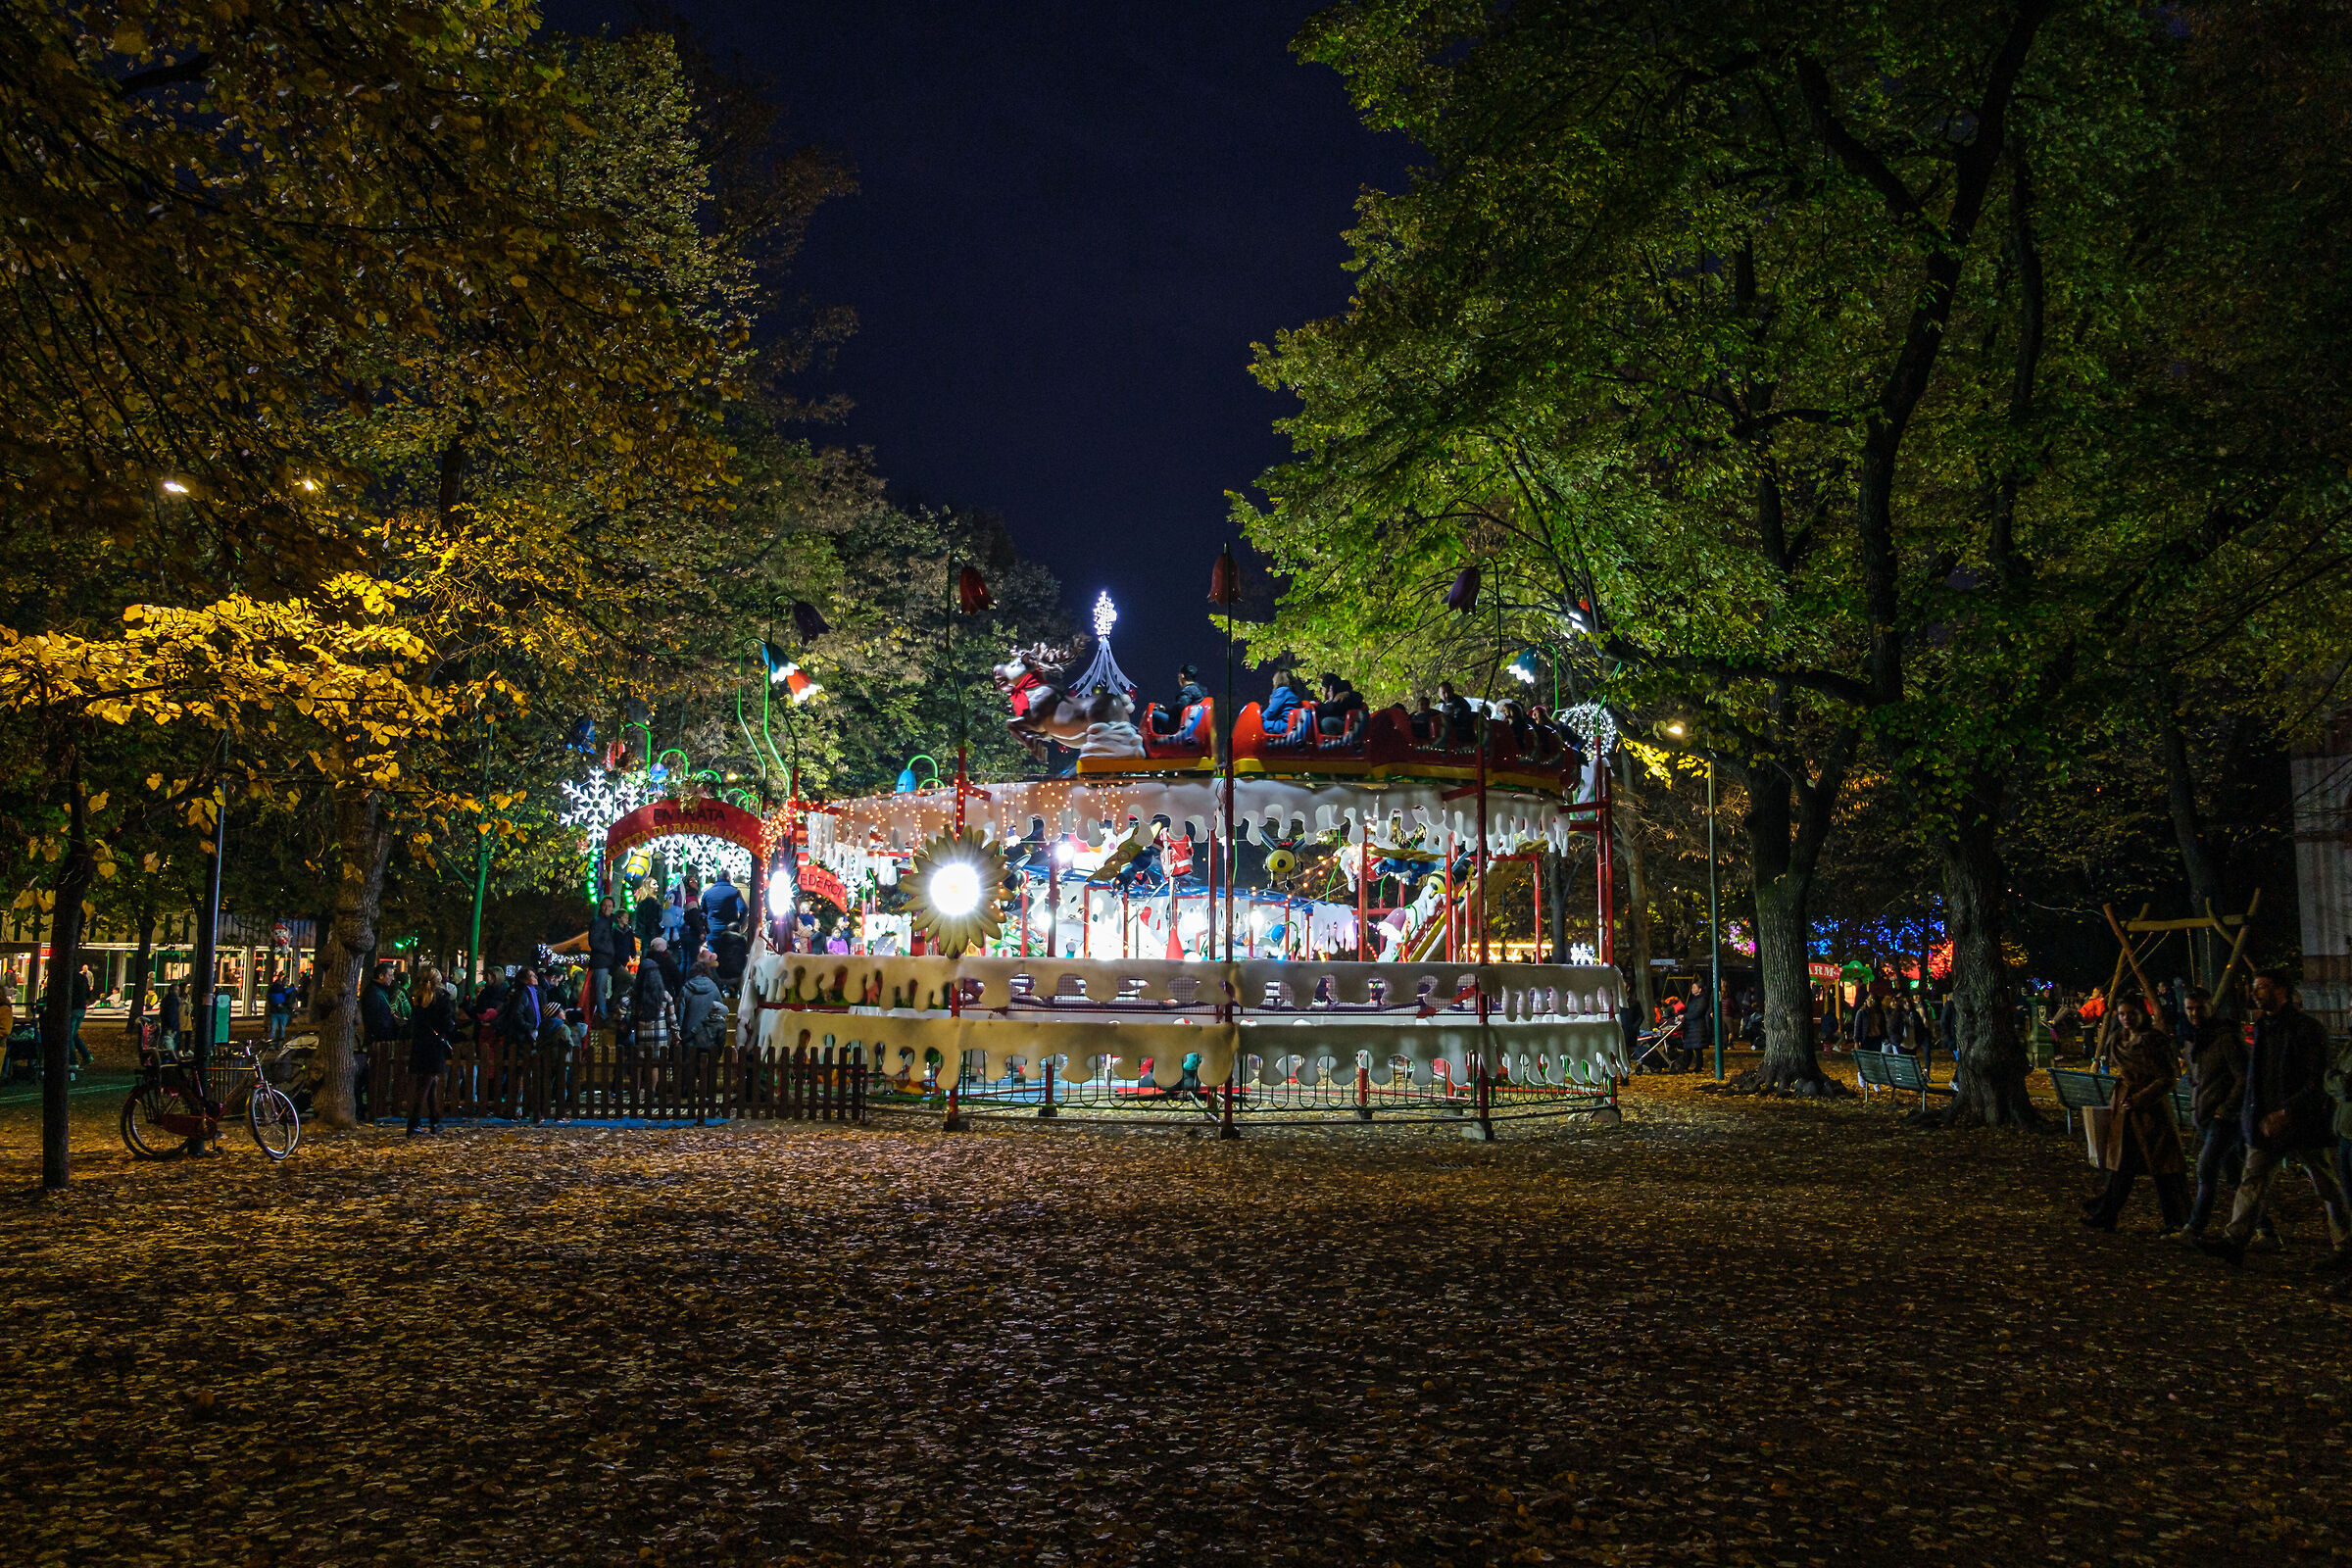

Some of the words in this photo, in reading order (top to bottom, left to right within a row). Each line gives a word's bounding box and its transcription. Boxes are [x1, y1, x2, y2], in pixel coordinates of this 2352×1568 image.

[654, 808, 725, 821] ENTRATA
[652, 825, 667, 836] DI
[672, 823, 719, 835] BABBO
[723, 829, 761, 857] NATAL
[799, 873, 842, 898] EDERCI
